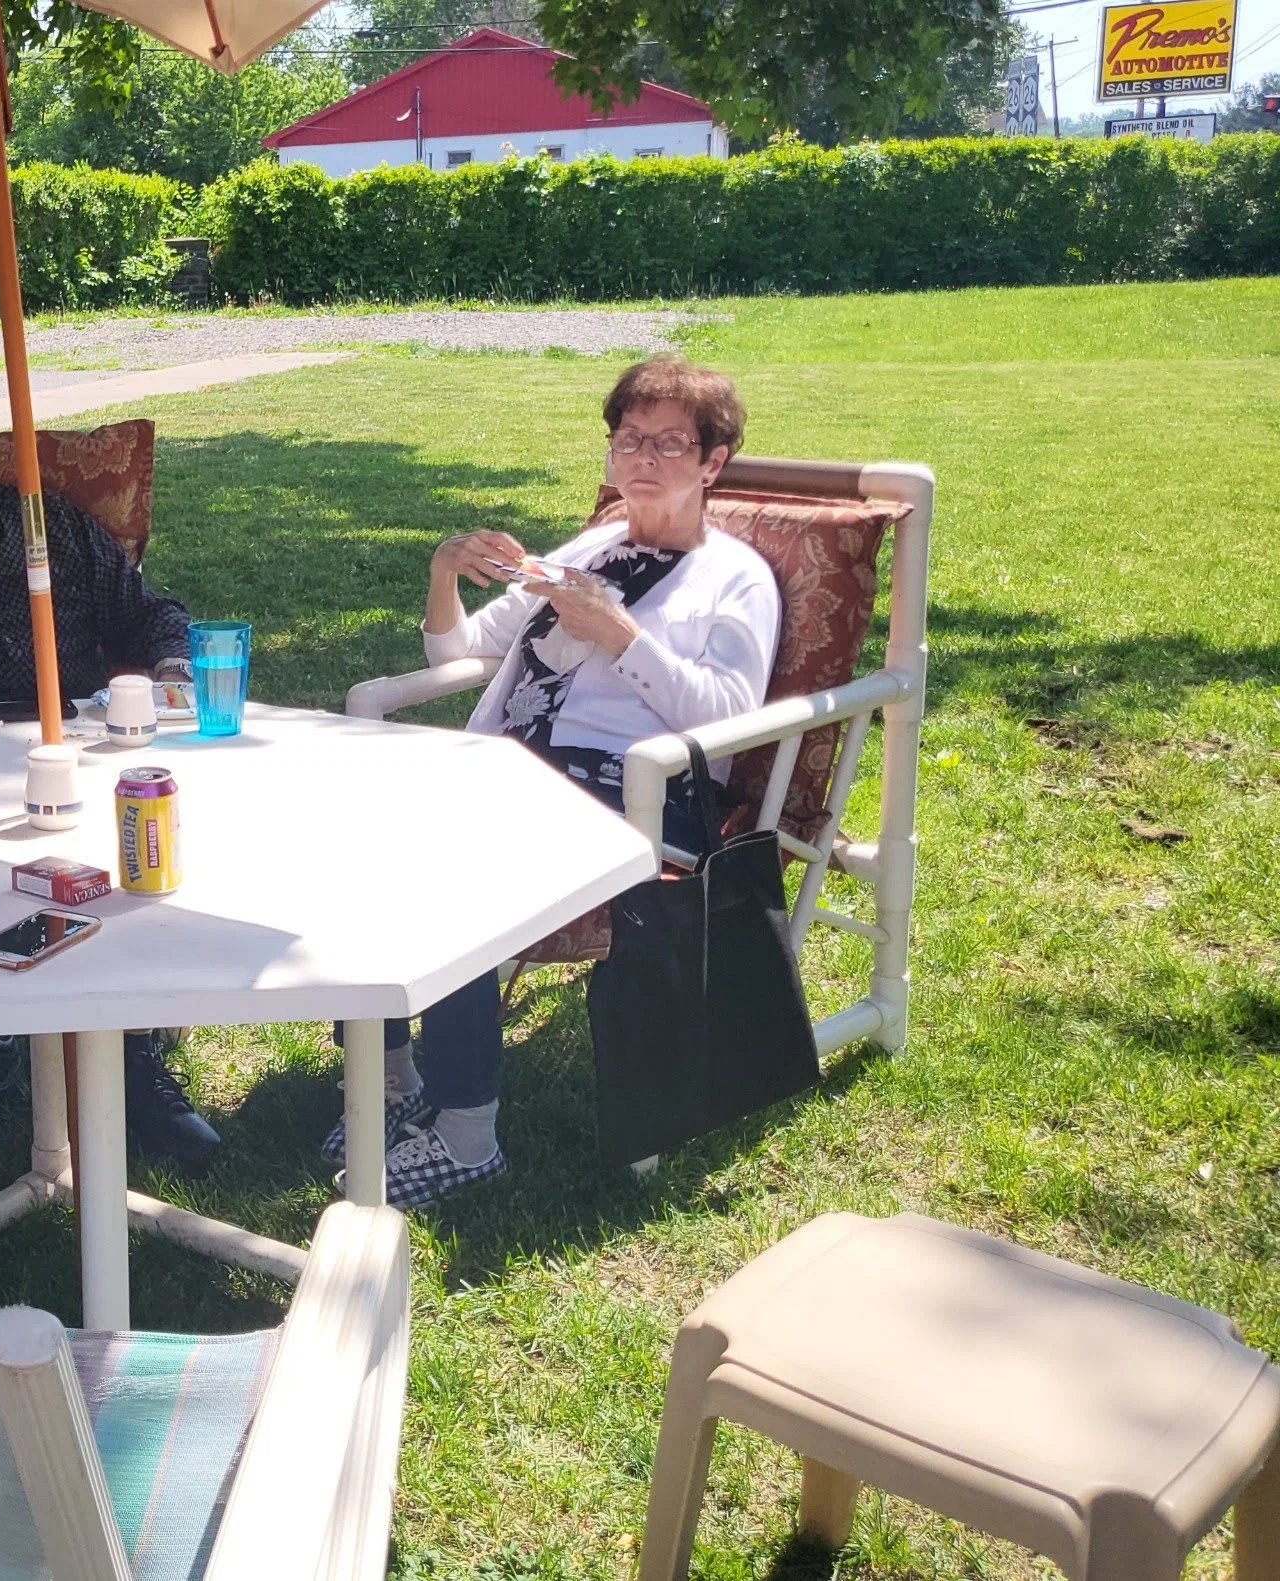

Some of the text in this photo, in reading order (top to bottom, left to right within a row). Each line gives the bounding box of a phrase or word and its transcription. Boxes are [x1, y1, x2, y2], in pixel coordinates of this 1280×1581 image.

[1106, 8, 1232, 64] Premo's
[1110, 52, 1229, 76] AUTOMOTIVE
[1025, 85, 1034, 104] 26
[1106, 76, 1224, 95] SALES SERVICE
[1009, 88, 1018, 107] 26
[1112, 119, 1194, 133] SYNTHETIC BLEND OIL
[123, 805, 142, 883] TWISTED TEA
[148, 821, 158, 867] RASPBERRY
[73, 883, 111, 903] SENECA
